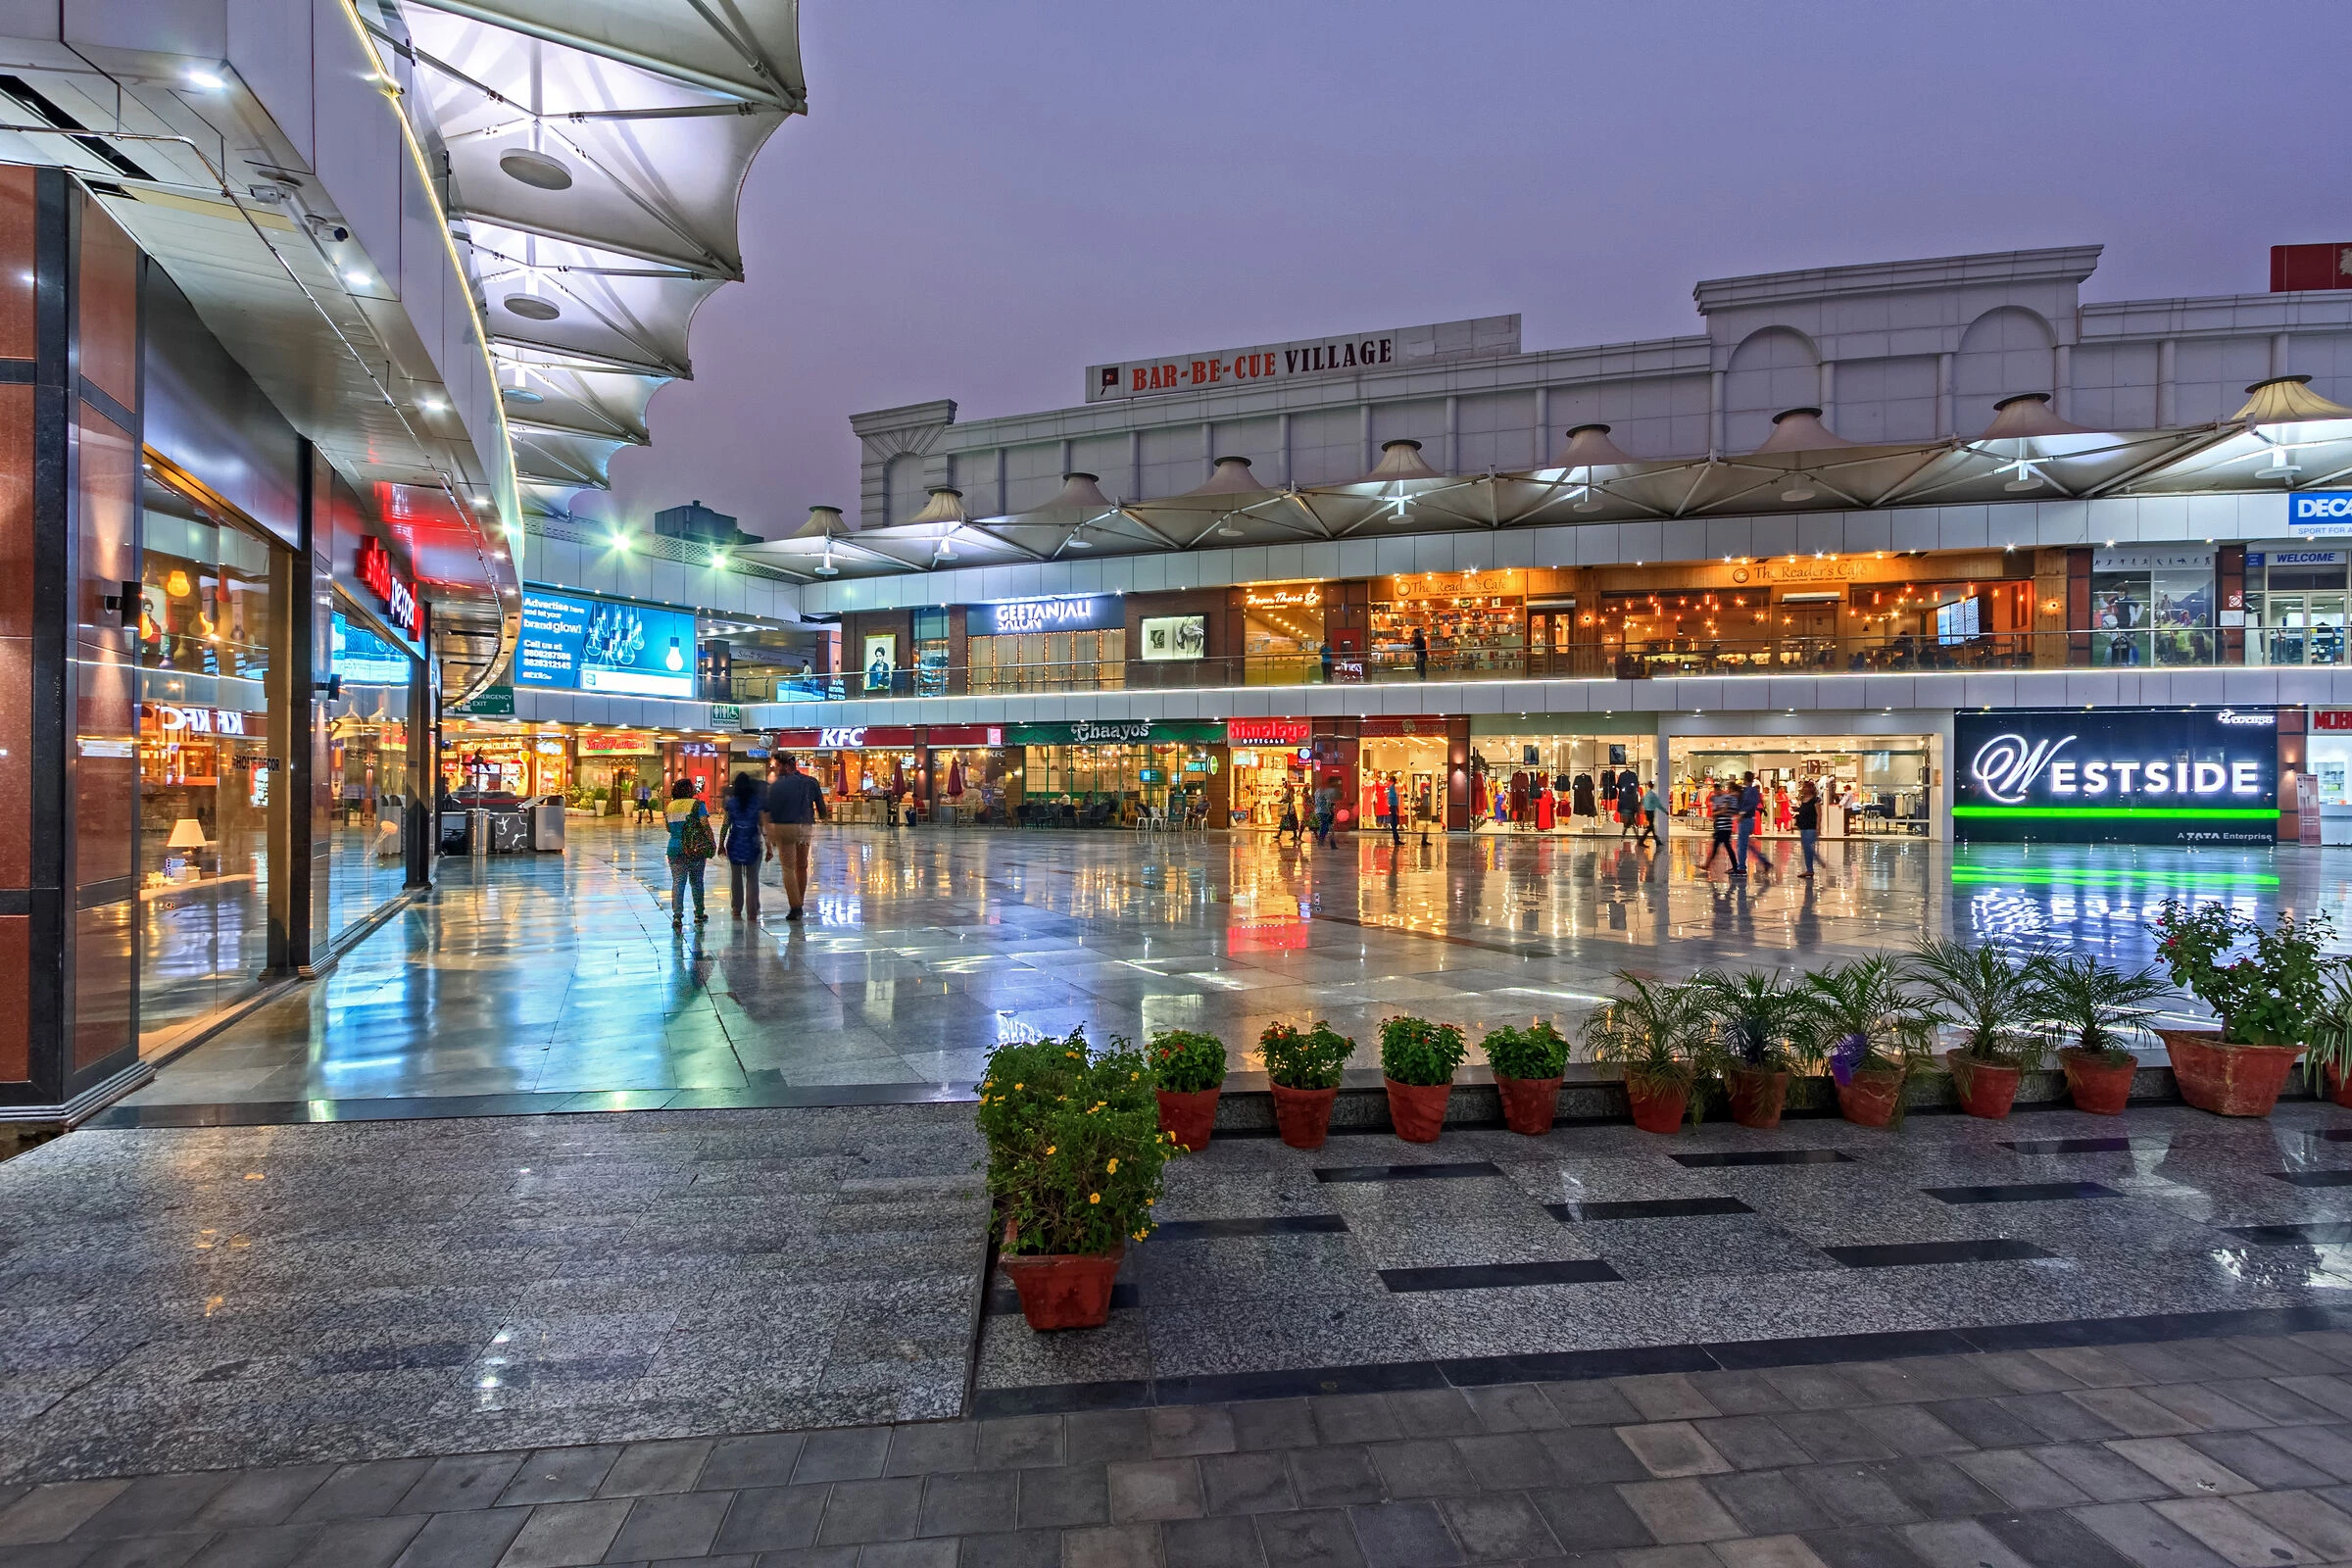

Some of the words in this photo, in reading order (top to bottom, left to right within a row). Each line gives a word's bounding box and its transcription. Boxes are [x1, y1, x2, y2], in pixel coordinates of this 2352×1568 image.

[1132, 352, 1276, 391] BAR-BE-CUE
[1285, 338, 1392, 373] VILLAGE
[2277, 553, 2335, 563] WELCOME
[524, 597, 569, 612] Advertise
[569, 606, 585, 614] here
[524, 608, 537, 616] and
[996, 601, 1091, 621] GEETANJALI
[523, 618, 553, 630] brand
[553, 620, 582, 634] glow!
[523, 639, 541, 649] Call
[542, 642, 553, 651] us
[553, 643, 563, 652] at
[819, 727, 864, 747] KFC
[1071, 723, 1150, 742] Chaayos
[1230, 720, 1309, 743] himalaya
[1972, 733, 2259, 803] WESTSIDE
[2186, 832, 2220, 841] TATA
[2223, 832, 2273, 842] Enterprise
